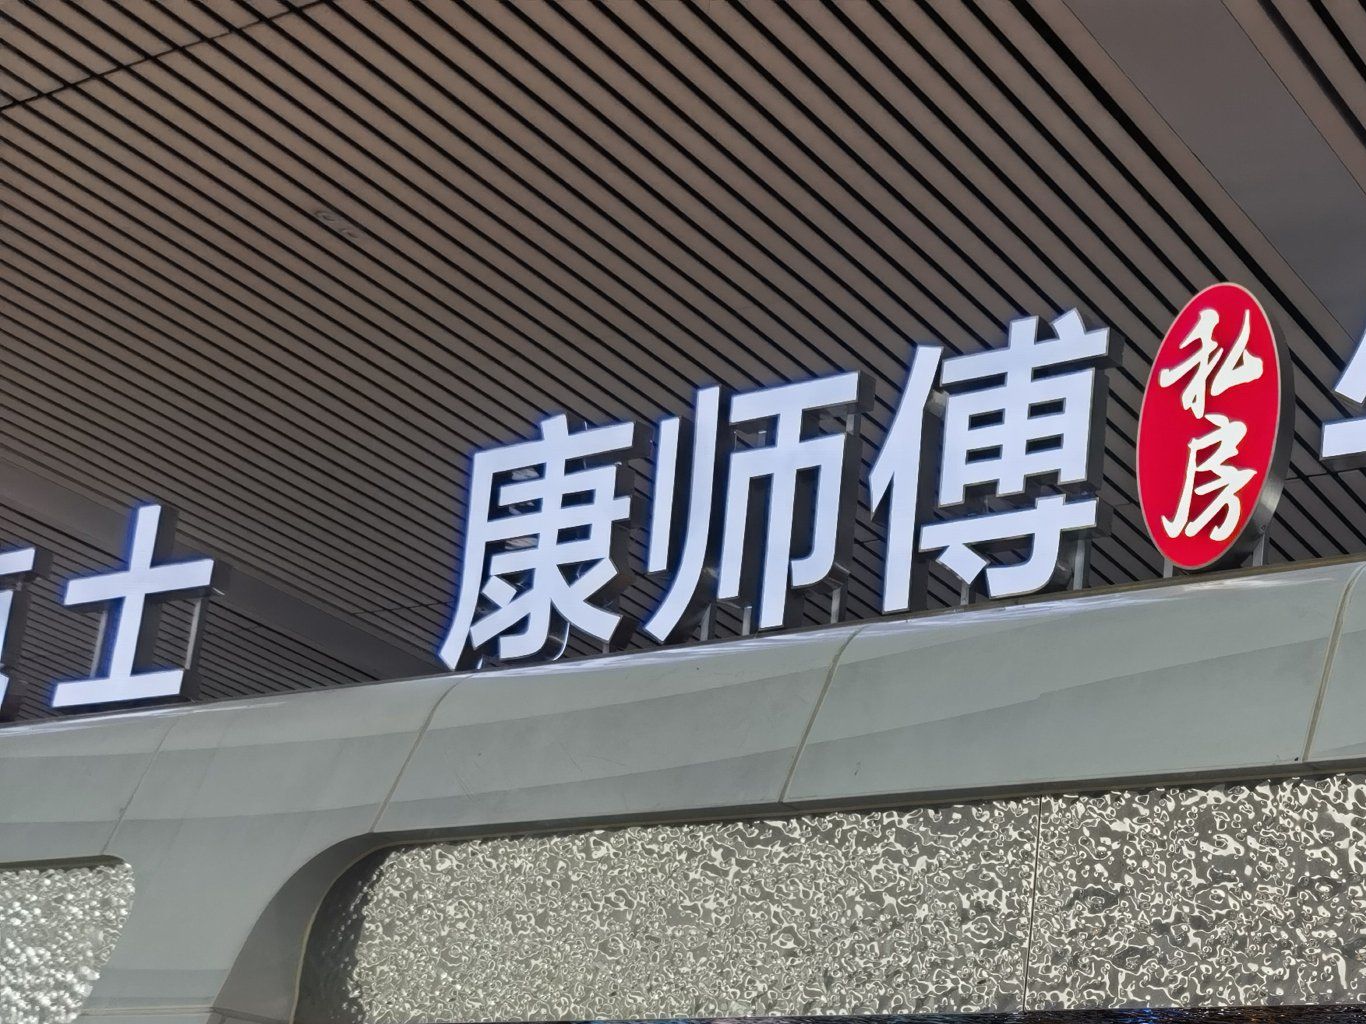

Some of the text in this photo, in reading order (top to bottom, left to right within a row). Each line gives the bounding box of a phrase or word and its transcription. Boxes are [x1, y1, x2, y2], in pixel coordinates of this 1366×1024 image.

[0, 504, 215, 718] 士
[439, 308, 1109, 670] 康师傅
[1160, 309, 1264, 541] 私房
